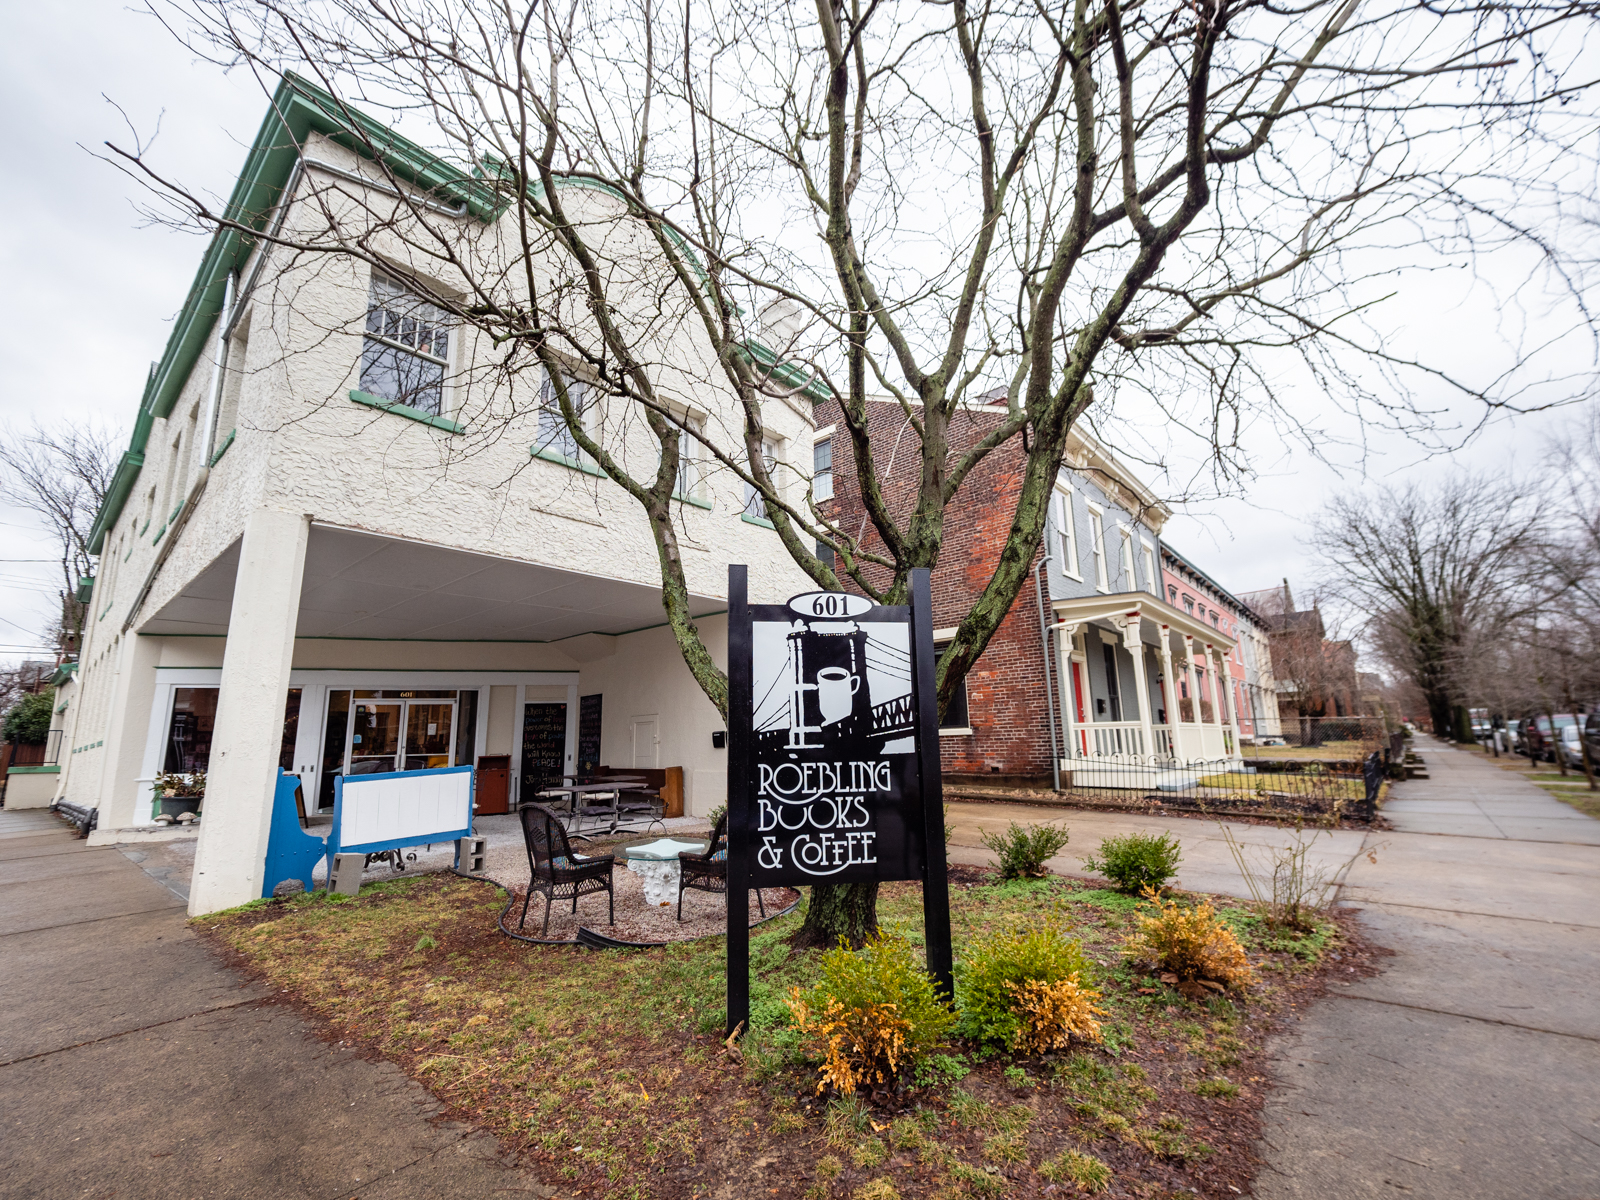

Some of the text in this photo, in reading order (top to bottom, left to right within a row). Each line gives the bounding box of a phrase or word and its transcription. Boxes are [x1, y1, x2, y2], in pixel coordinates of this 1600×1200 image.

[812, 595, 850, 616] 601
[539, 731, 548, 740] of
[757, 761, 892, 805] ROEBLING
[757, 796, 870, 832] BOOKS
[757, 831, 878, 876] & COFFEE
